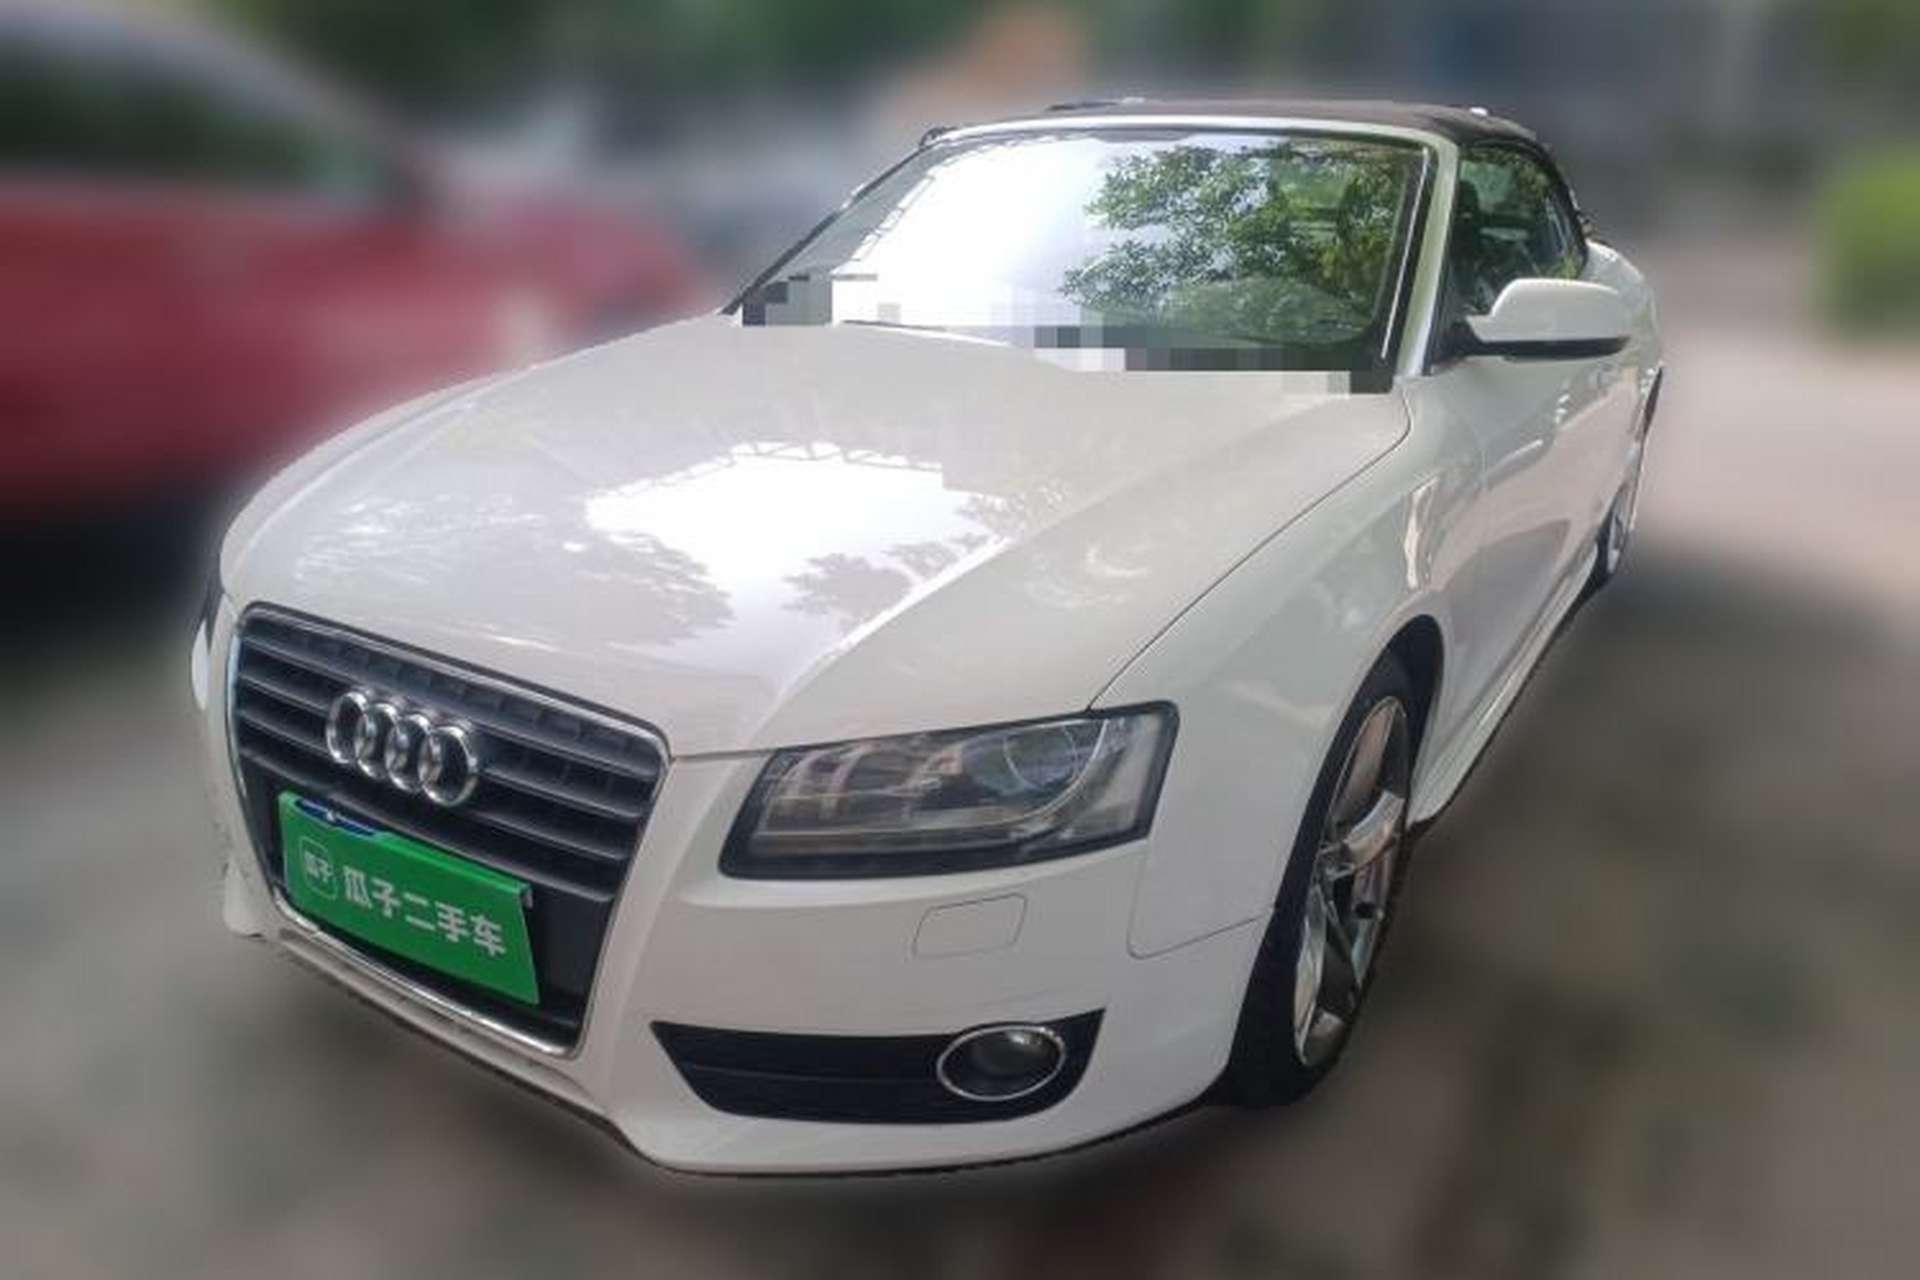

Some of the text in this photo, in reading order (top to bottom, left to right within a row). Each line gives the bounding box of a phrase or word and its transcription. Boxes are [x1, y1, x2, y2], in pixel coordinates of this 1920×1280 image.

[343, 865, 506, 957] 瓜子二手车
